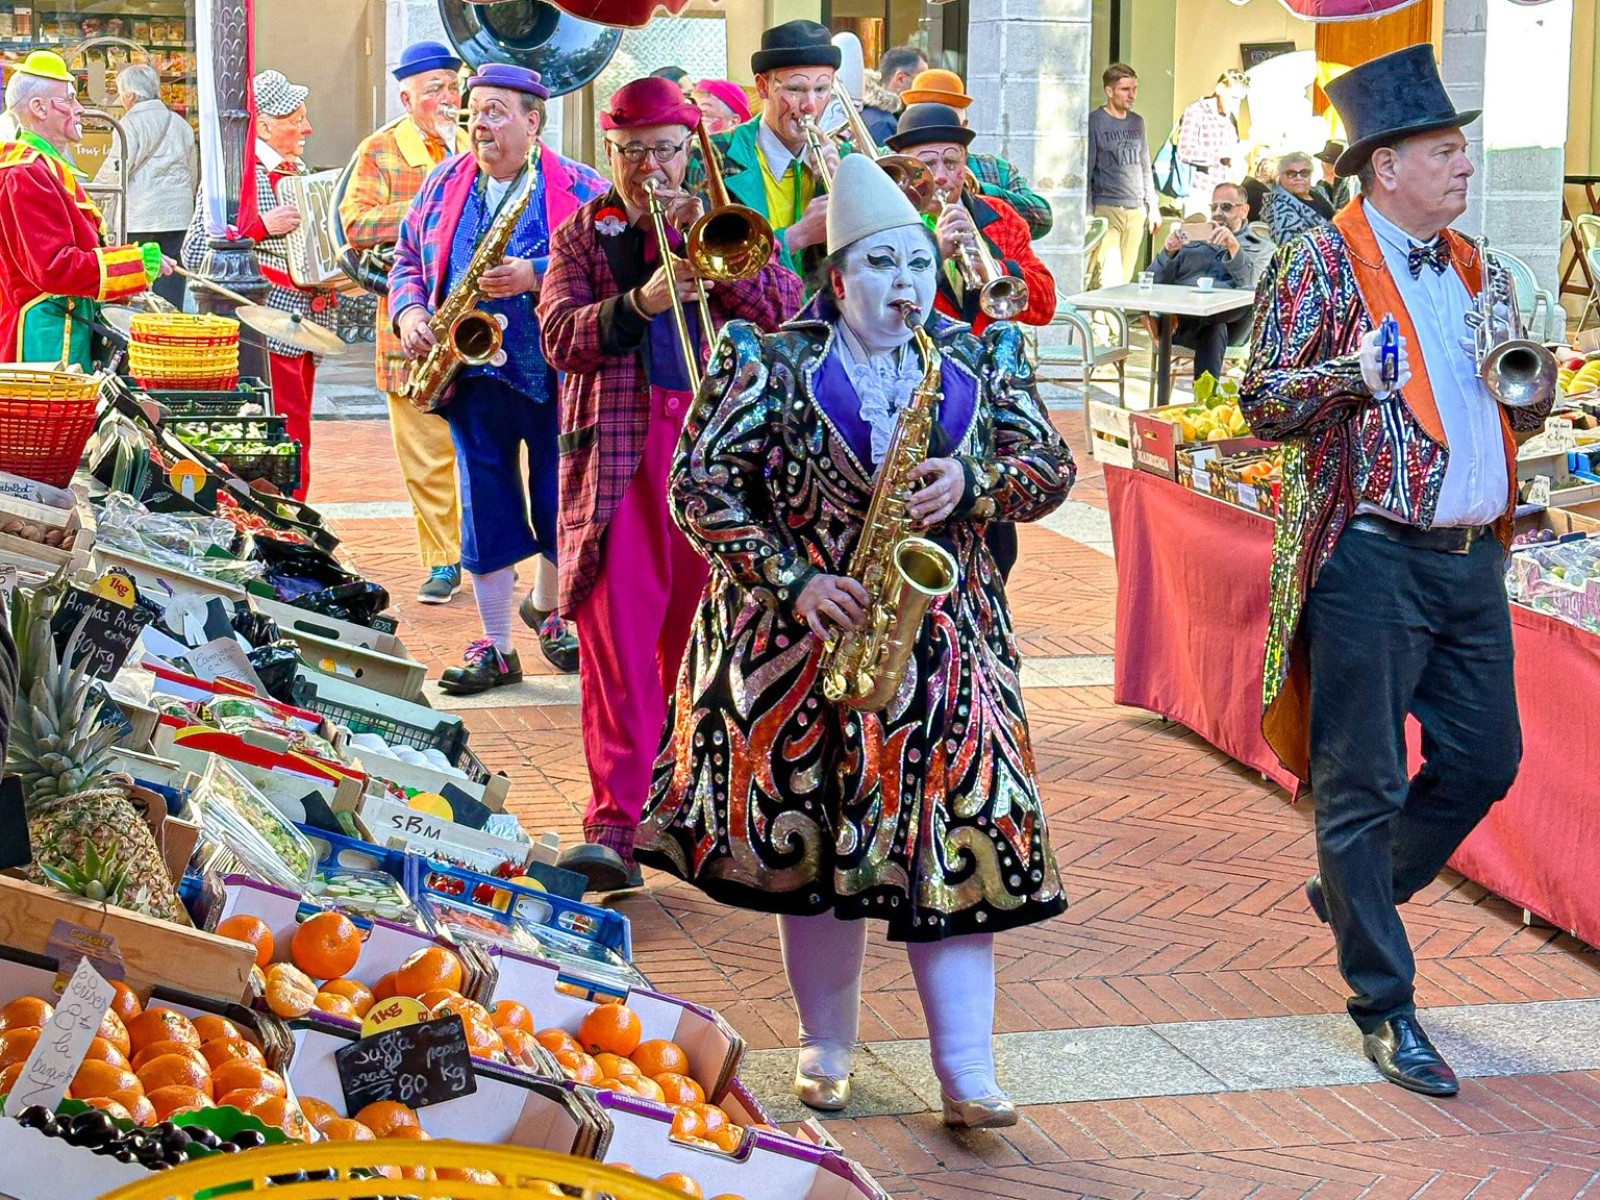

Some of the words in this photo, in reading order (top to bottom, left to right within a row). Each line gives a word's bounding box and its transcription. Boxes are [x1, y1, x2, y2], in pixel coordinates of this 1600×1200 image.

[74, 143, 100, 155] Tous
[109, 577, 129, 598] 1kg
[370, 1002, 403, 1025] 1kg
